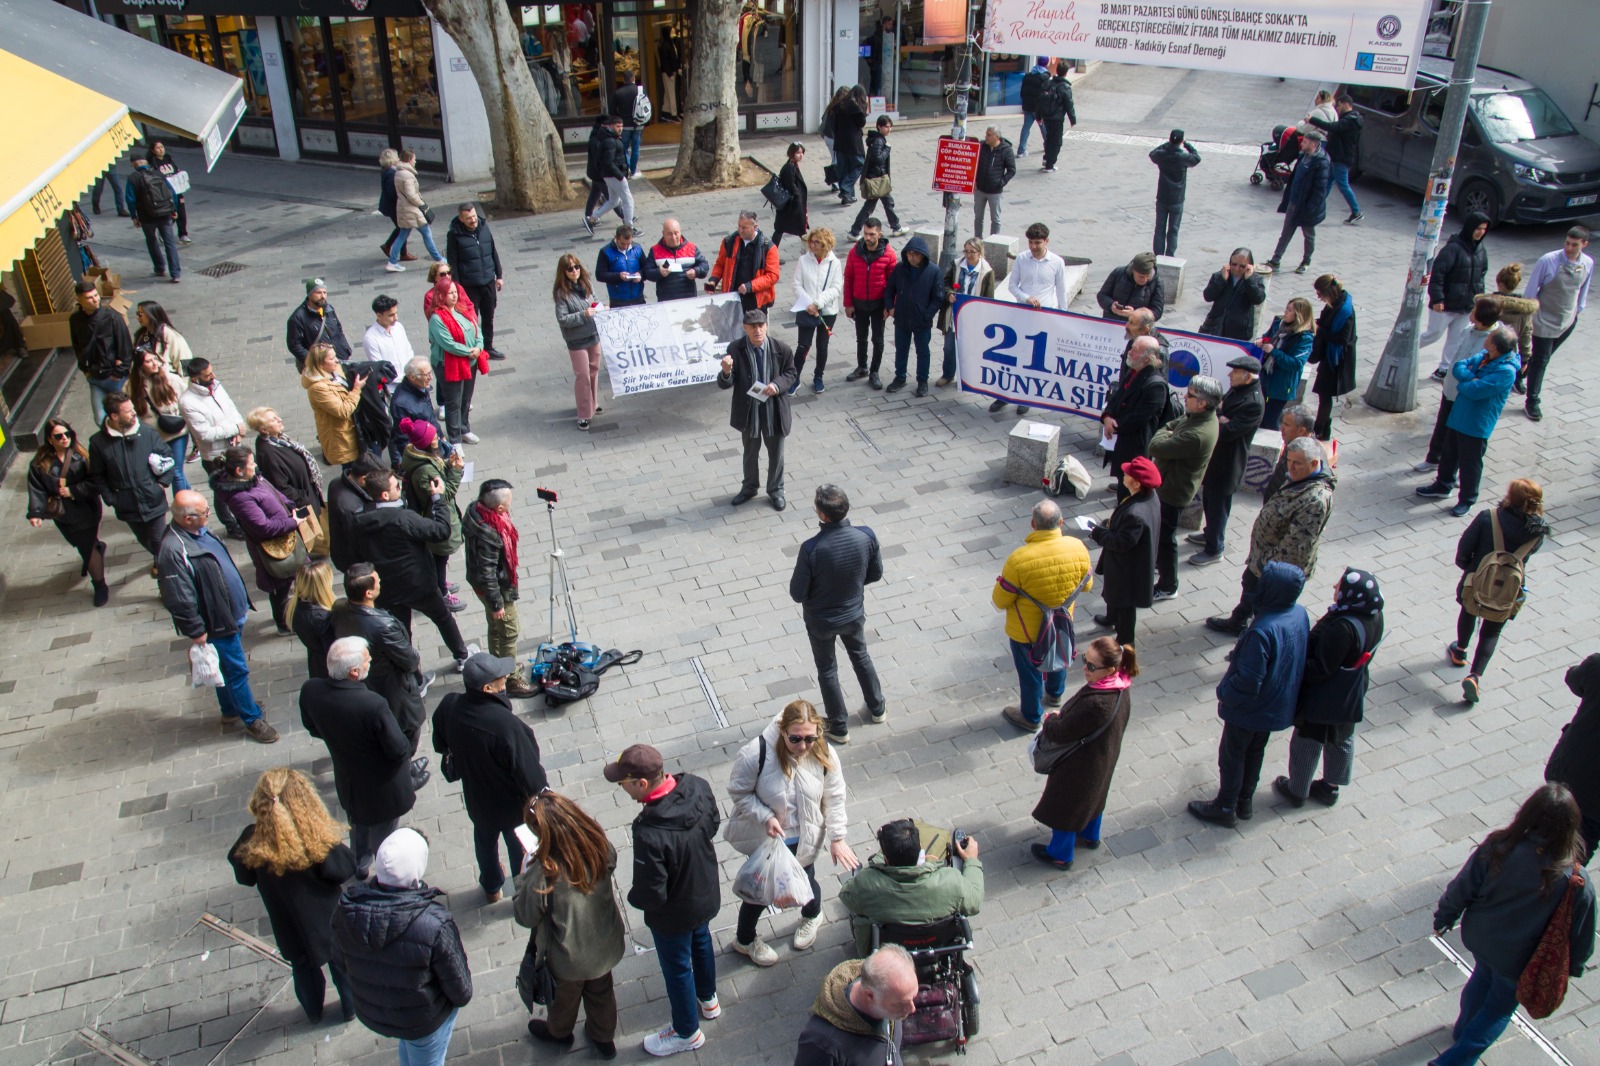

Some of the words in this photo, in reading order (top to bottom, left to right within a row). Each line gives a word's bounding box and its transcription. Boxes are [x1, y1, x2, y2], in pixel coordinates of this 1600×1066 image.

[1027, 0, 1076, 28] Hayırlı
[1100, 3, 1109, 14] 18
[1110, 4, 1131, 15] MART
[1133, 5, 1175, 18] PAZARTESİ
[1176, 5, 1199, 20] GÜNÜ
[1200, 6, 1263, 25] GÜNEŞLİBAHÇE
[1265, 12, 1308, 26] SOKAK'TA
[1009, 20, 1091, 45] Ramazanlar
[1097, 19, 1189, 36] GERÇEKLEŞTİRECEĞİMİZ
[1190, 22, 1219, 38] İFTARA
[1221, 25, 1239, 40] TÜM
[1241, 28, 1283, 43] HALKIMIZ
[1284, 31, 1338, 48] DAVETLİDİR.
[1095, 36, 1128, 49] KADIDER
[1134, 39, 1166, 54] Kadıköy
[1168, 42, 1192, 54] Esnaf
[1193, 43, 1227, 59] Derneği
[108, 120, 132, 149] EYFEL
[29, 183, 62, 223] EYFEL
[982, 323, 1052, 374] 21
[1056, 337, 1091, 348] YAZARLAR
[1080, 333, 1112, 343] TÜRKİYE
[1076, 350, 1103, 360] Syndicate
[624, 382, 654, 393] Dostluk
[667, 377, 689, 386] Güzel
[691, 373, 714, 383] Sözler
[639, 371, 673, 382] Yolcuları
[980, 365, 1066, 402] DÜNYA
[1070, 384, 1107, 410] Şİİ
